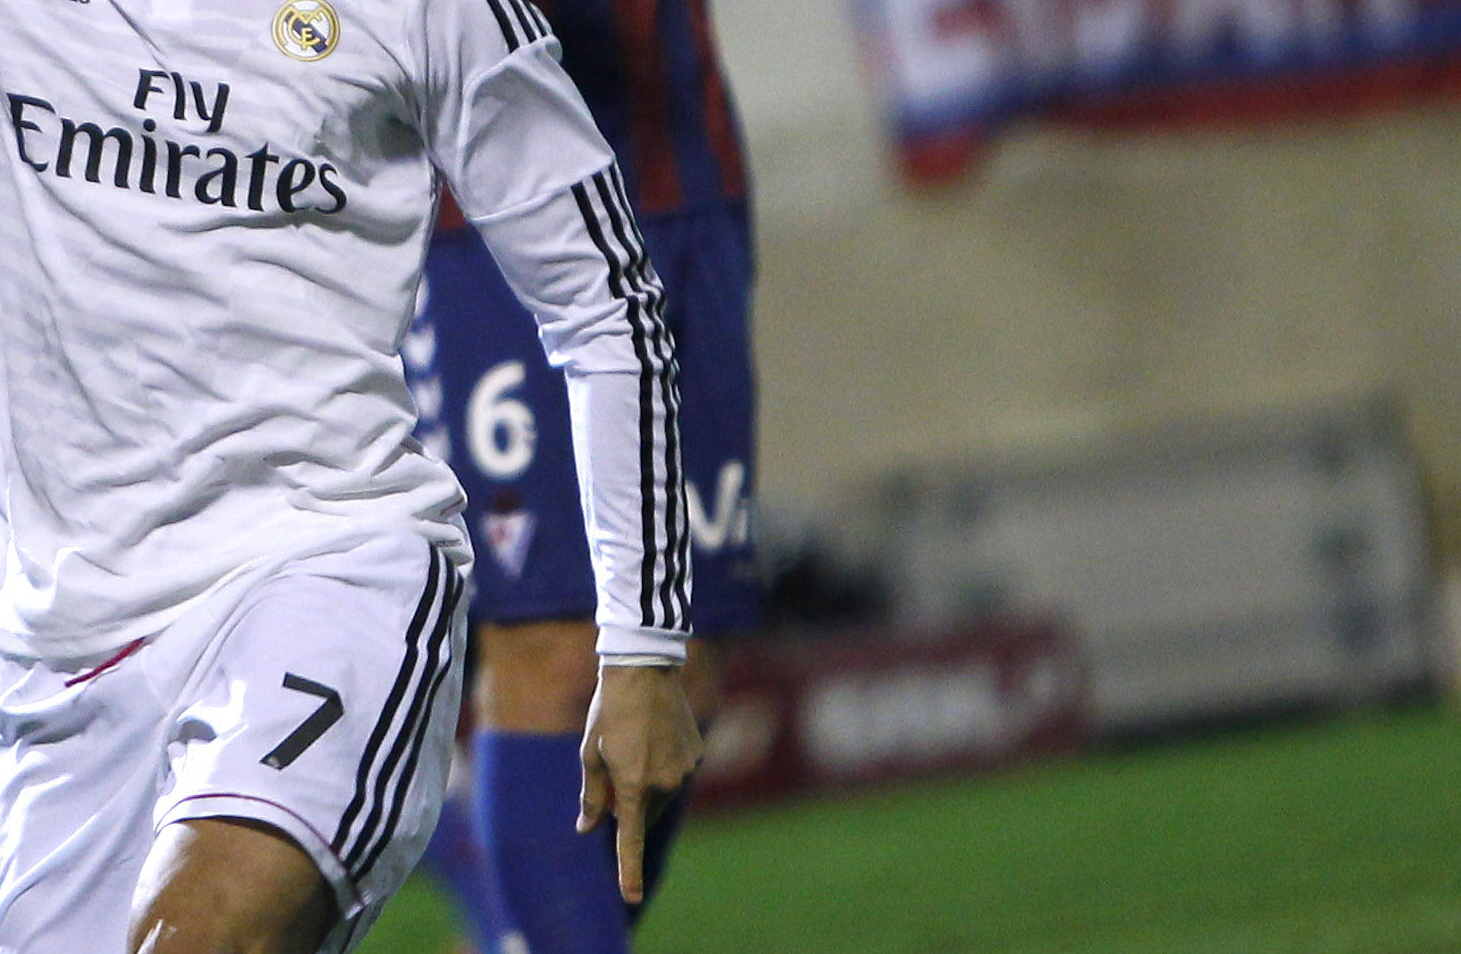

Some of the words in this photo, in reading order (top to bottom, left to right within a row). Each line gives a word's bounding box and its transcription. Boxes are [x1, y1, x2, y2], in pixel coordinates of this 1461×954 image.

[6, 92, 348, 215] Emirates
[133, 67, 231, 133] Fly
[466, 358, 537, 480] 6
[258, 671, 345, 771] 7
